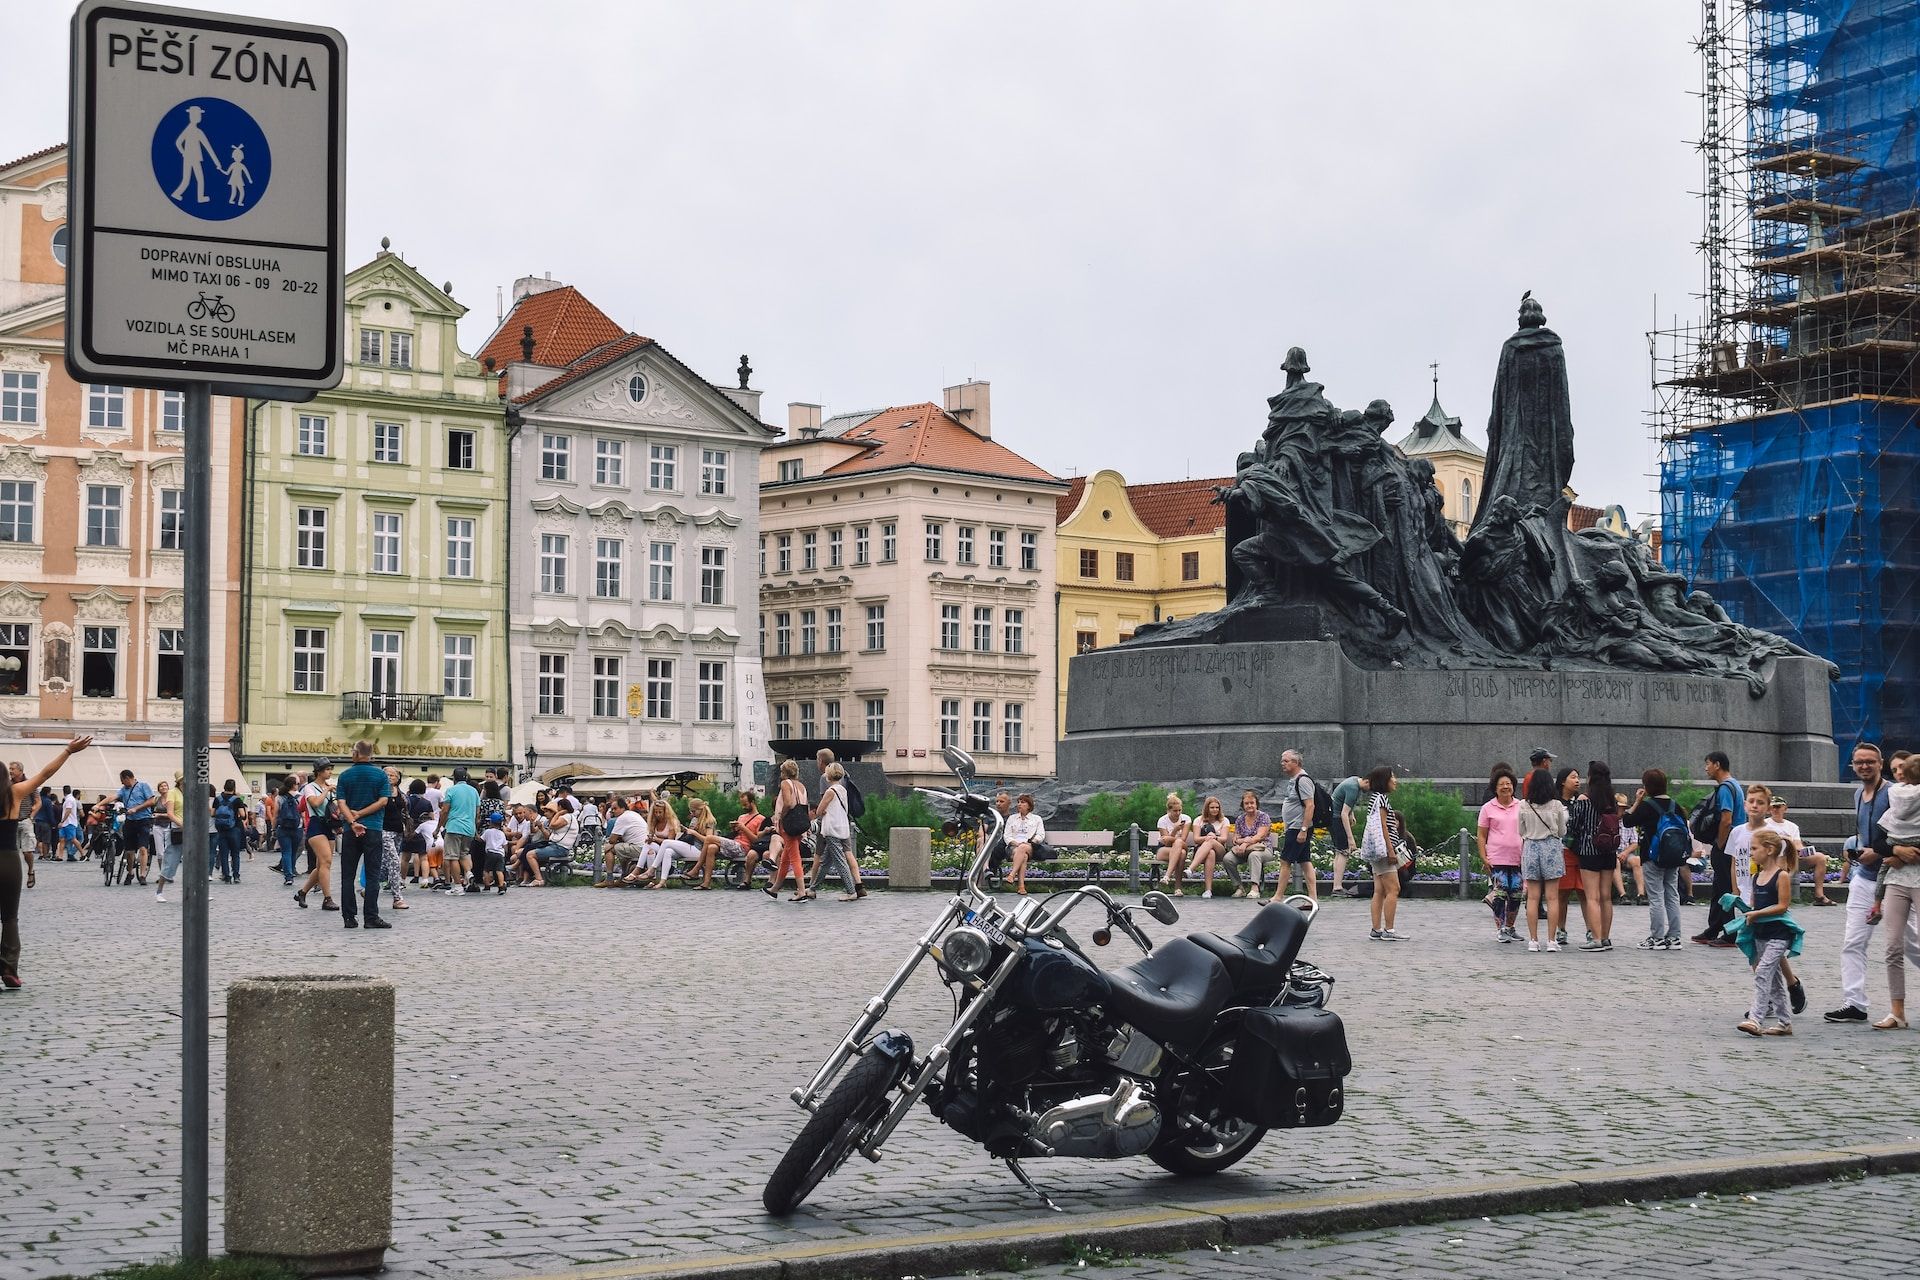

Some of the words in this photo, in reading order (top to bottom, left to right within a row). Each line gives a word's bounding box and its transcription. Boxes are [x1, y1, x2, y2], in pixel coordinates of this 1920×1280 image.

[108, 27, 198, 77] PĚŠÍ
[210, 41, 317, 92] ZÓNA
[140, 247, 212, 267] DOPRAVNÍ
[215, 254, 281, 273] OBSLUHA
[151, 267, 189, 283] MIMO
[192, 271, 222, 287] TAXI
[224, 274, 241, 288] 06
[254, 276, 270, 290] 09
[281, 279, 319, 295] 20-22
[125, 318, 186, 336] VOZIDLA
[189, 324, 208, 338] SE
[210, 325, 296, 345] SOUHLASEM
[167, 339, 189, 355] MČ
[191, 343, 240, 359] PRAHA
[243, 347, 250, 360] 1
[745, 674, 757, 747] HOTEL
[260, 736, 381, 756] STAROMĚSTÁ
[387, 743, 483, 758] RESTAURACE
[197, 746, 209, 785] BOGUS
[971, 915, 1004, 943] HARALD
